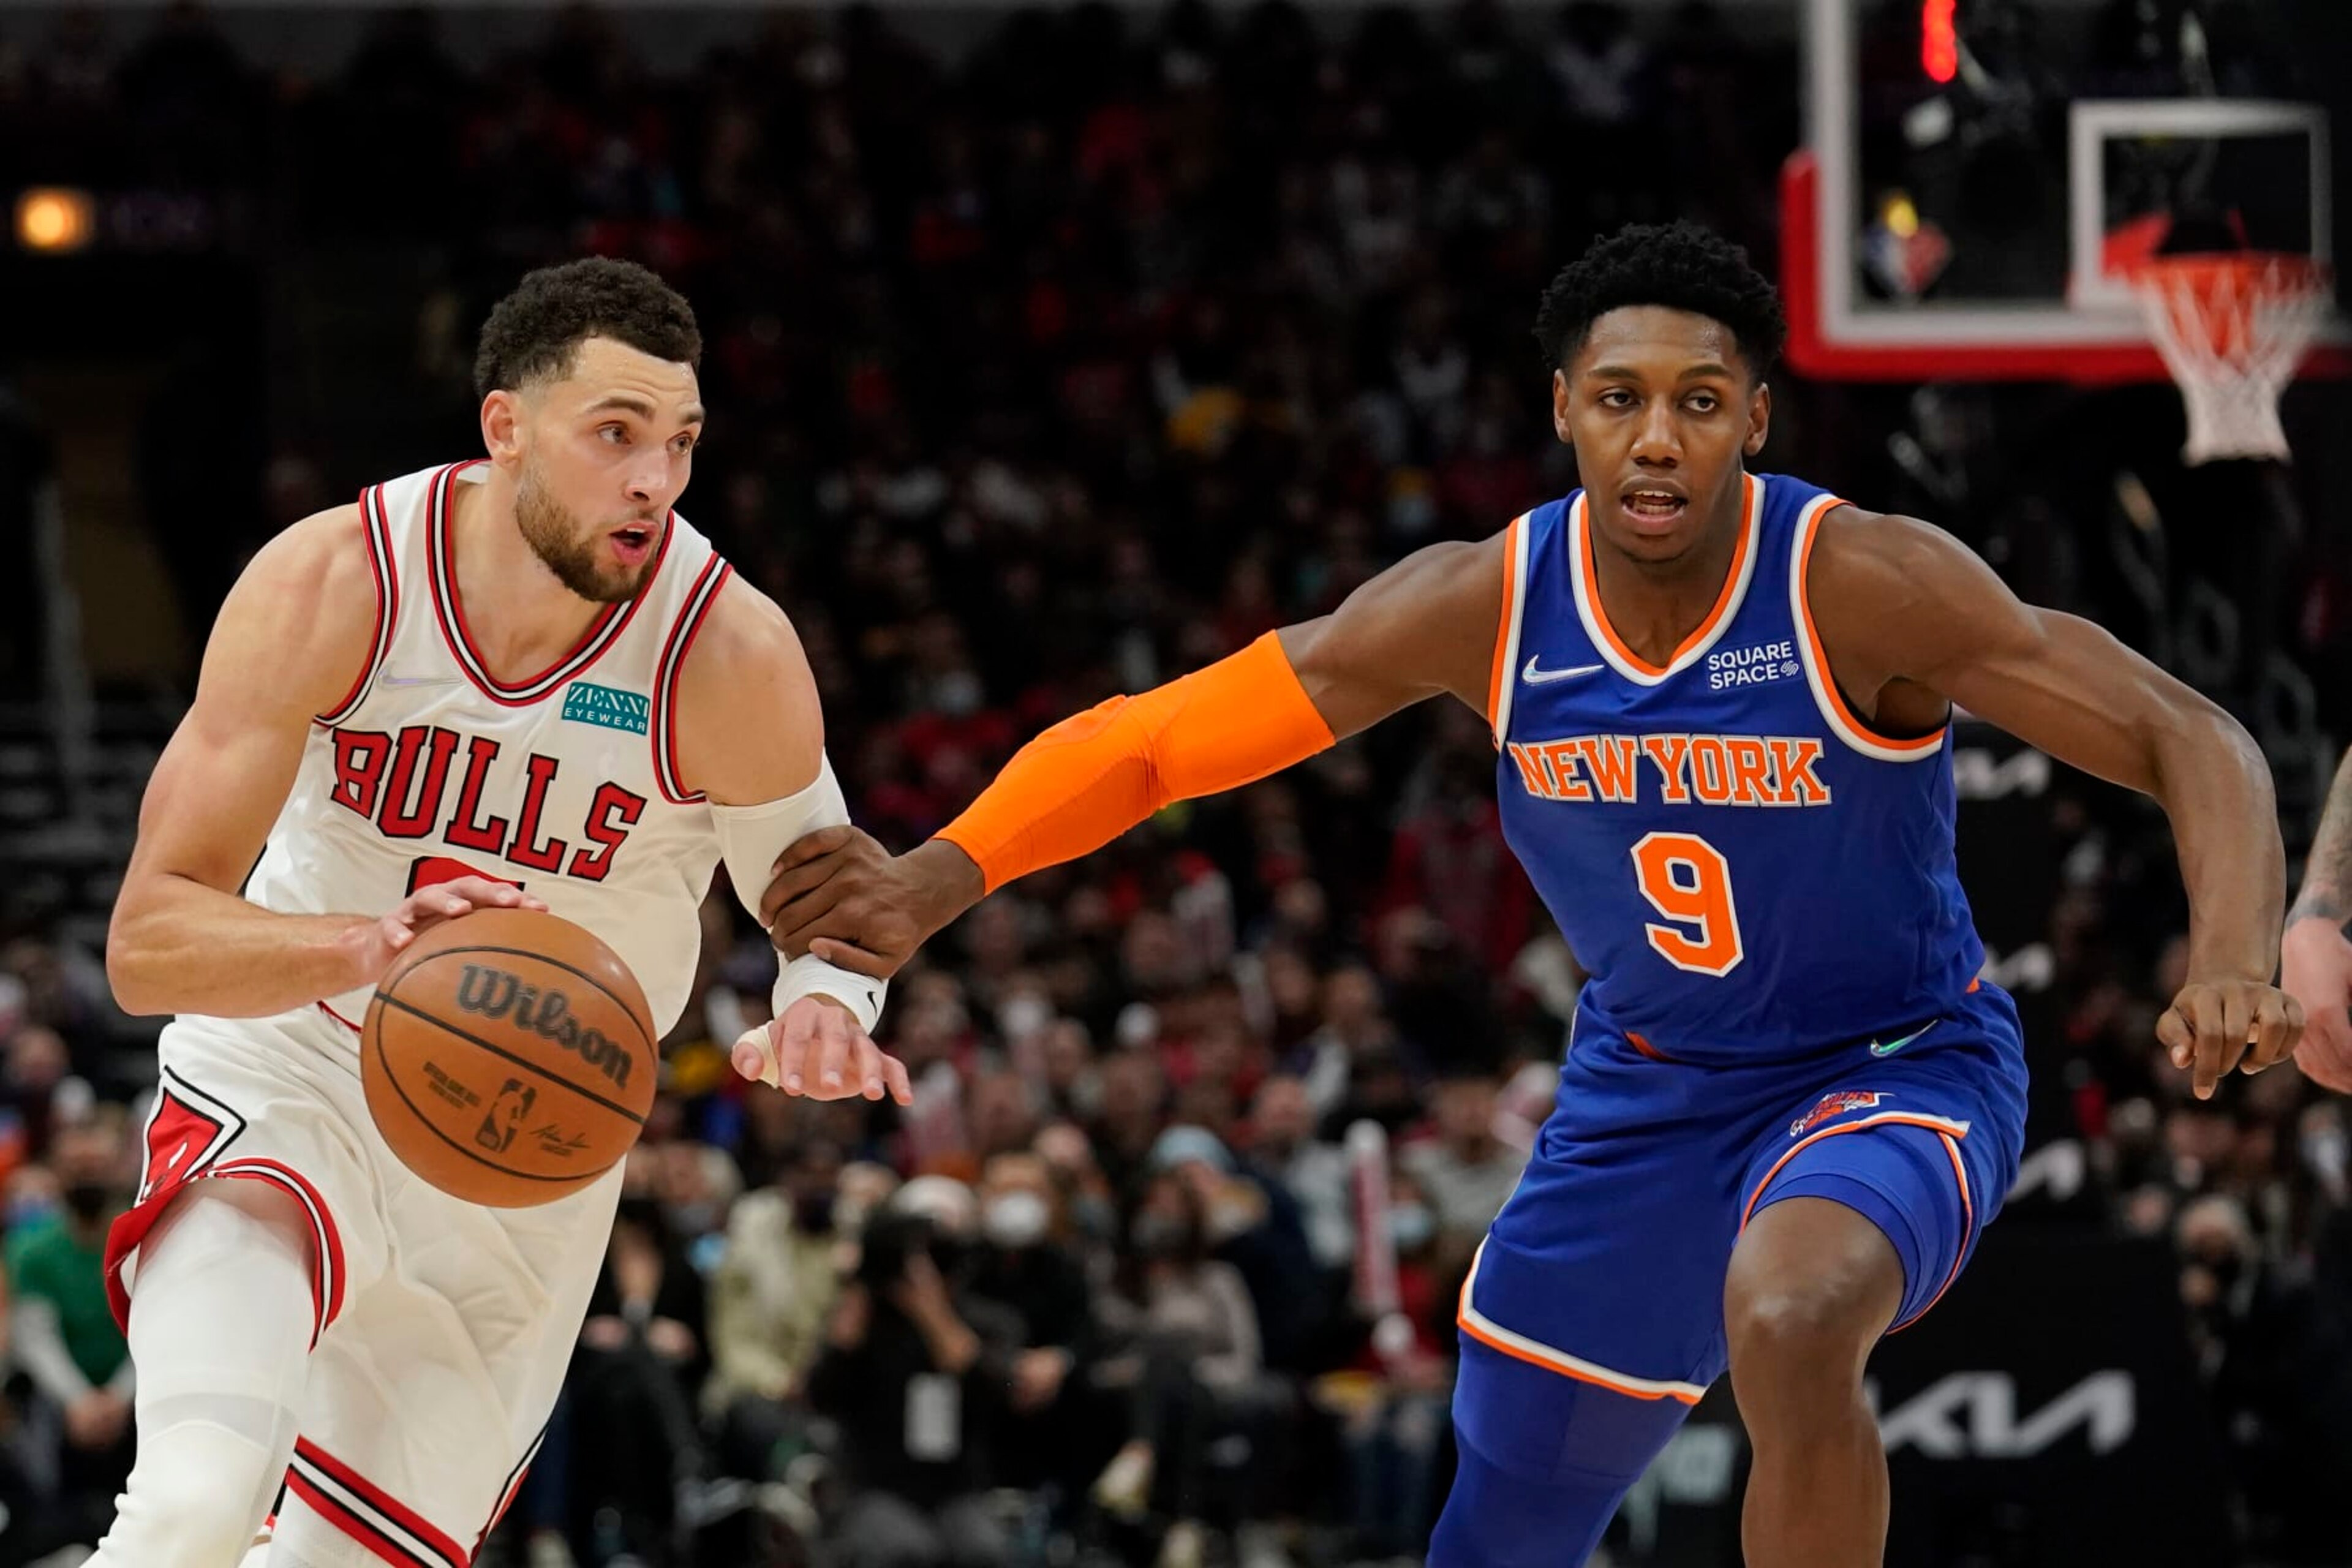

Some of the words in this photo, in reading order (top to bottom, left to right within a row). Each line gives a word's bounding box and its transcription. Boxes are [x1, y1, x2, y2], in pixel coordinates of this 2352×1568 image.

[1708, 641, 1793, 671] SQUARE
[1710, 663, 1779, 690] SPACE
[564, 707, 646, 732] EYEWEAR
[331, 725, 647, 882] BULLS
[1506, 734, 1640, 804] NEW
[1639, 733, 1833, 807] YORK
[1630, 831, 1744, 979] 9
[458, 963, 631, 1090] Wilson
